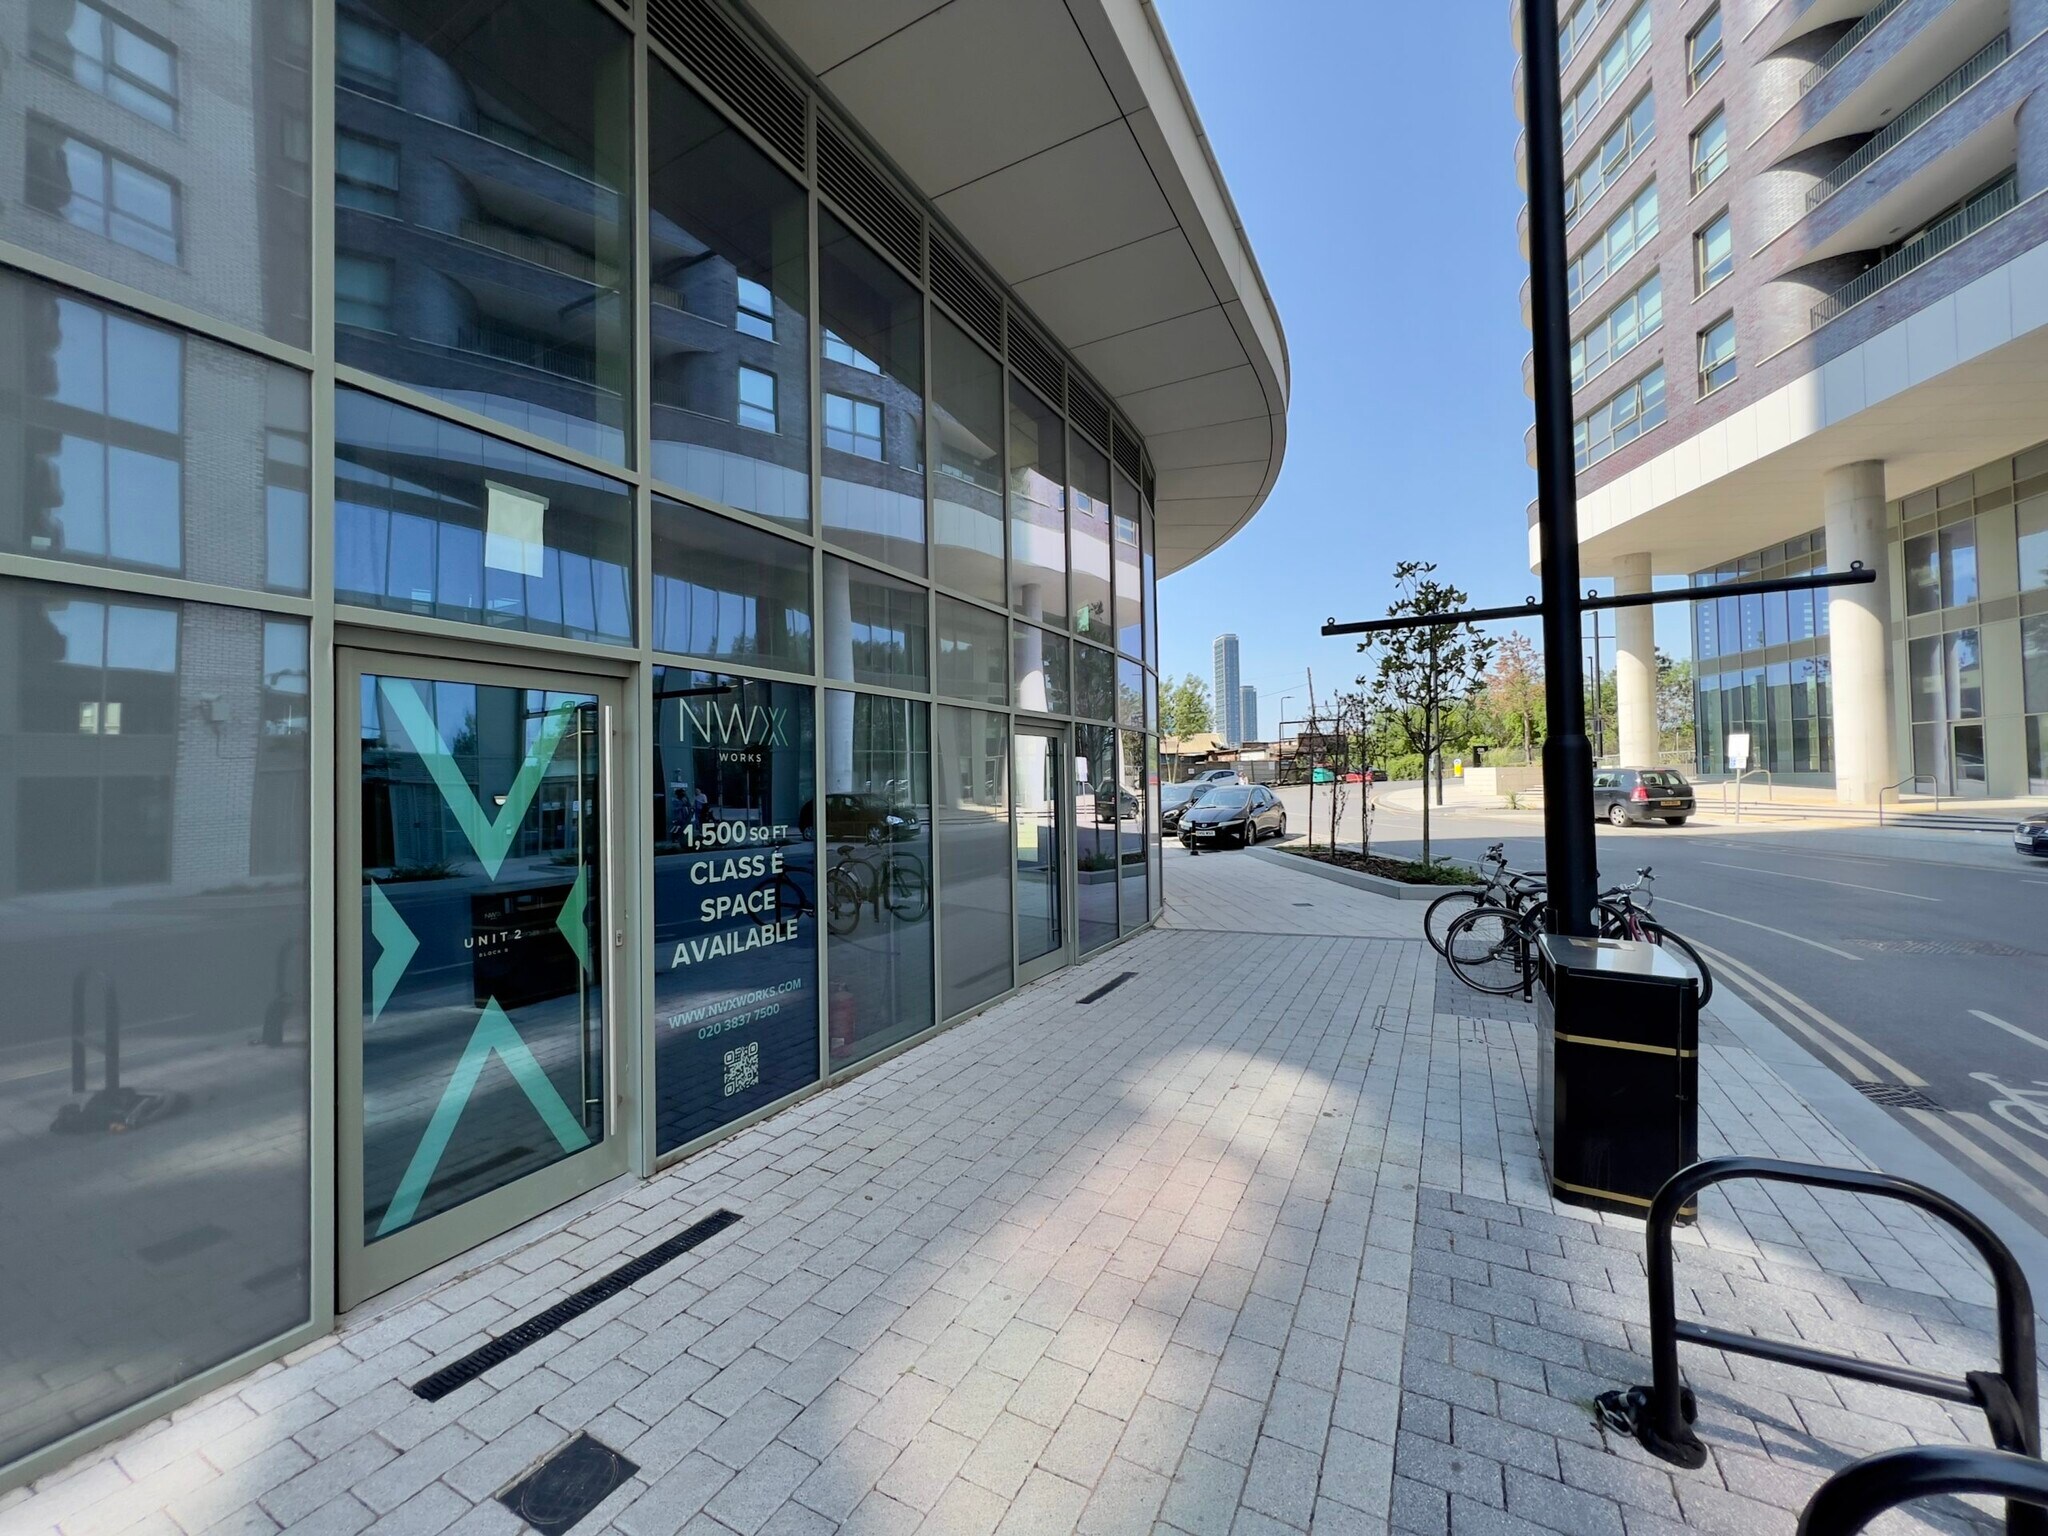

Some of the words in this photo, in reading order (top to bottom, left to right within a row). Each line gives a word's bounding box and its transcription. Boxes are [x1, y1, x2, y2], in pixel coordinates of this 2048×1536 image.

[679, 698, 788, 746] NWX
[719, 753, 762, 762] WORKS
[683, 821, 746, 850] 1,500
[750, 826, 769, 841] SQ
[772, 825, 789, 839] FT
[690, 855, 765, 885] CLASS
[772, 852, 784, 874] E
[700, 888, 776, 922] SPACE
[464, 931, 508, 949] UNIT
[514, 929, 522, 939] 2
[671, 919, 798, 968] AVAILABLE
[669, 978, 801, 1029] WWW.NWXWORKS.COM
[698, 1023, 721, 1040] 020
[724, 1012, 751, 1031] 3837
[755, 1003, 780, 1021] 7500
